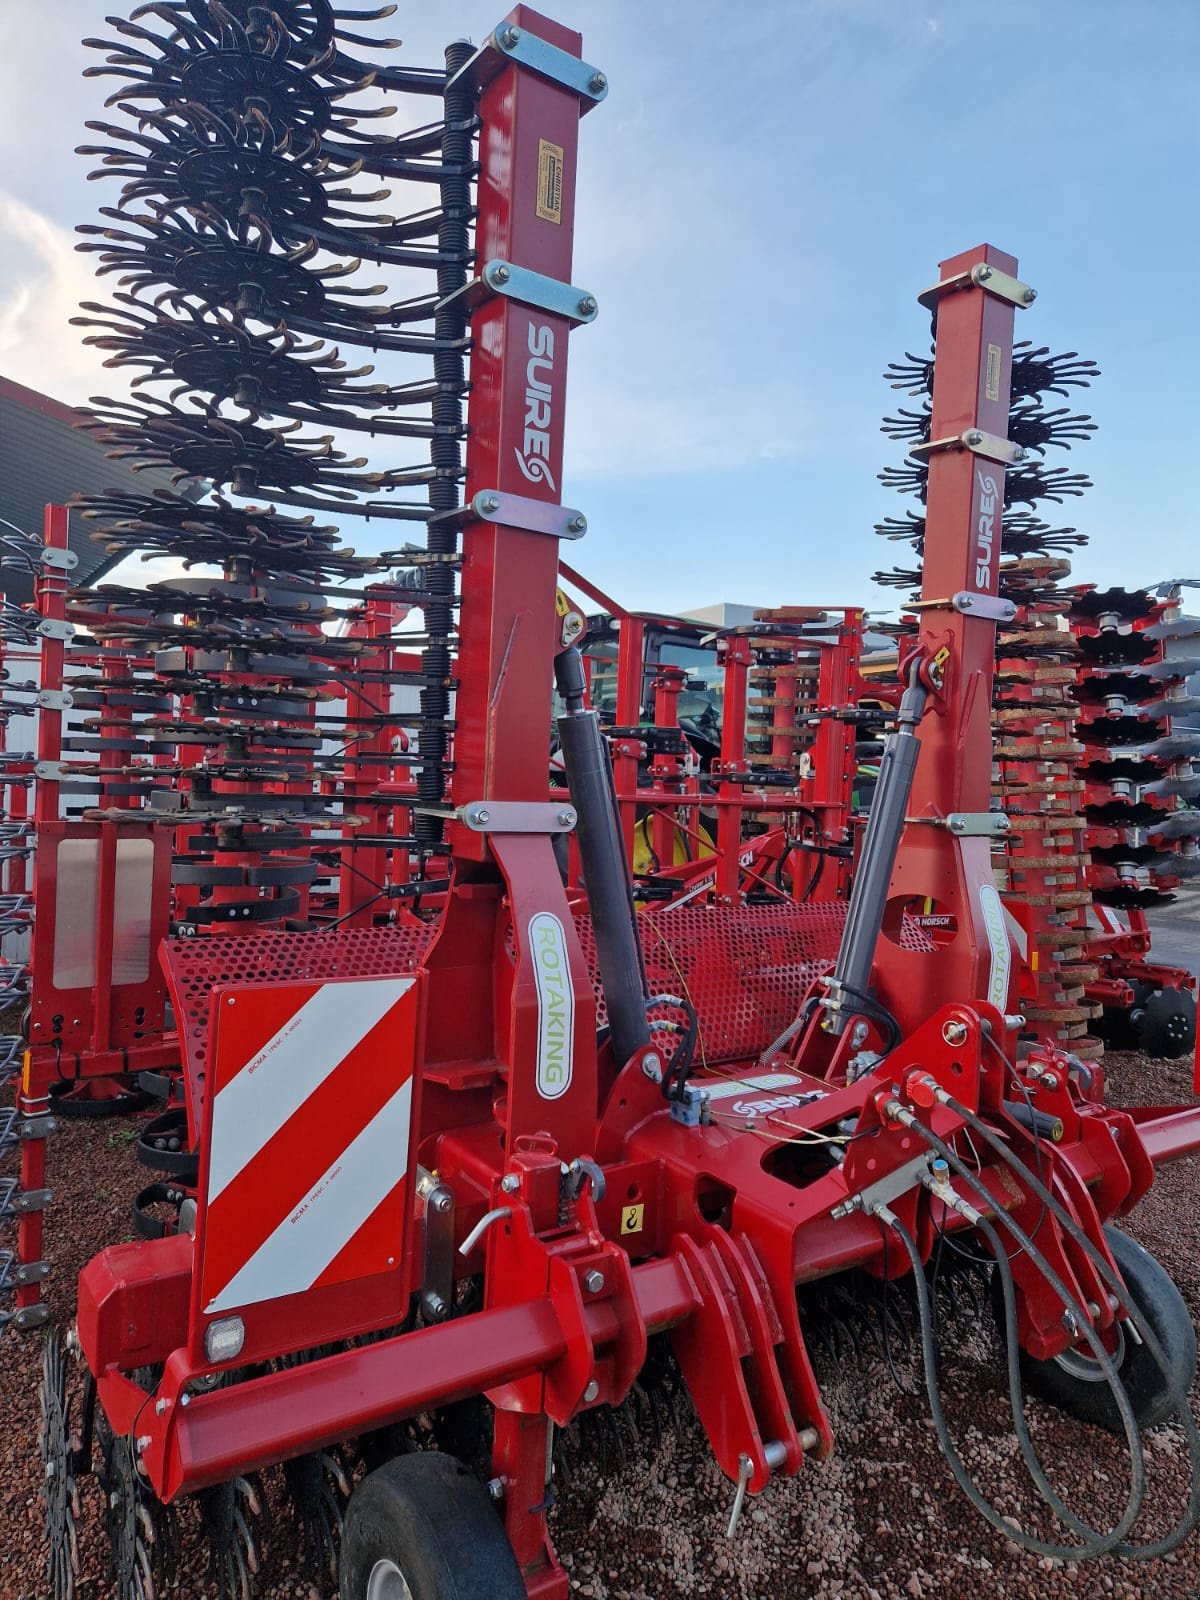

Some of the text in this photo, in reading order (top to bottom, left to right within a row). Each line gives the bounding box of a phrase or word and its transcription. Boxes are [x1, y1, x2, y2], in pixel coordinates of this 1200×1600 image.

[554, 166, 562, 212] CHRISTIAN
[524, 320, 554, 462] SUIRE
[975, 493, 995, 591] SUIRE
[921, 916, 950, 927] HORSCH
[536, 926, 565, 1084] ROTAKING
